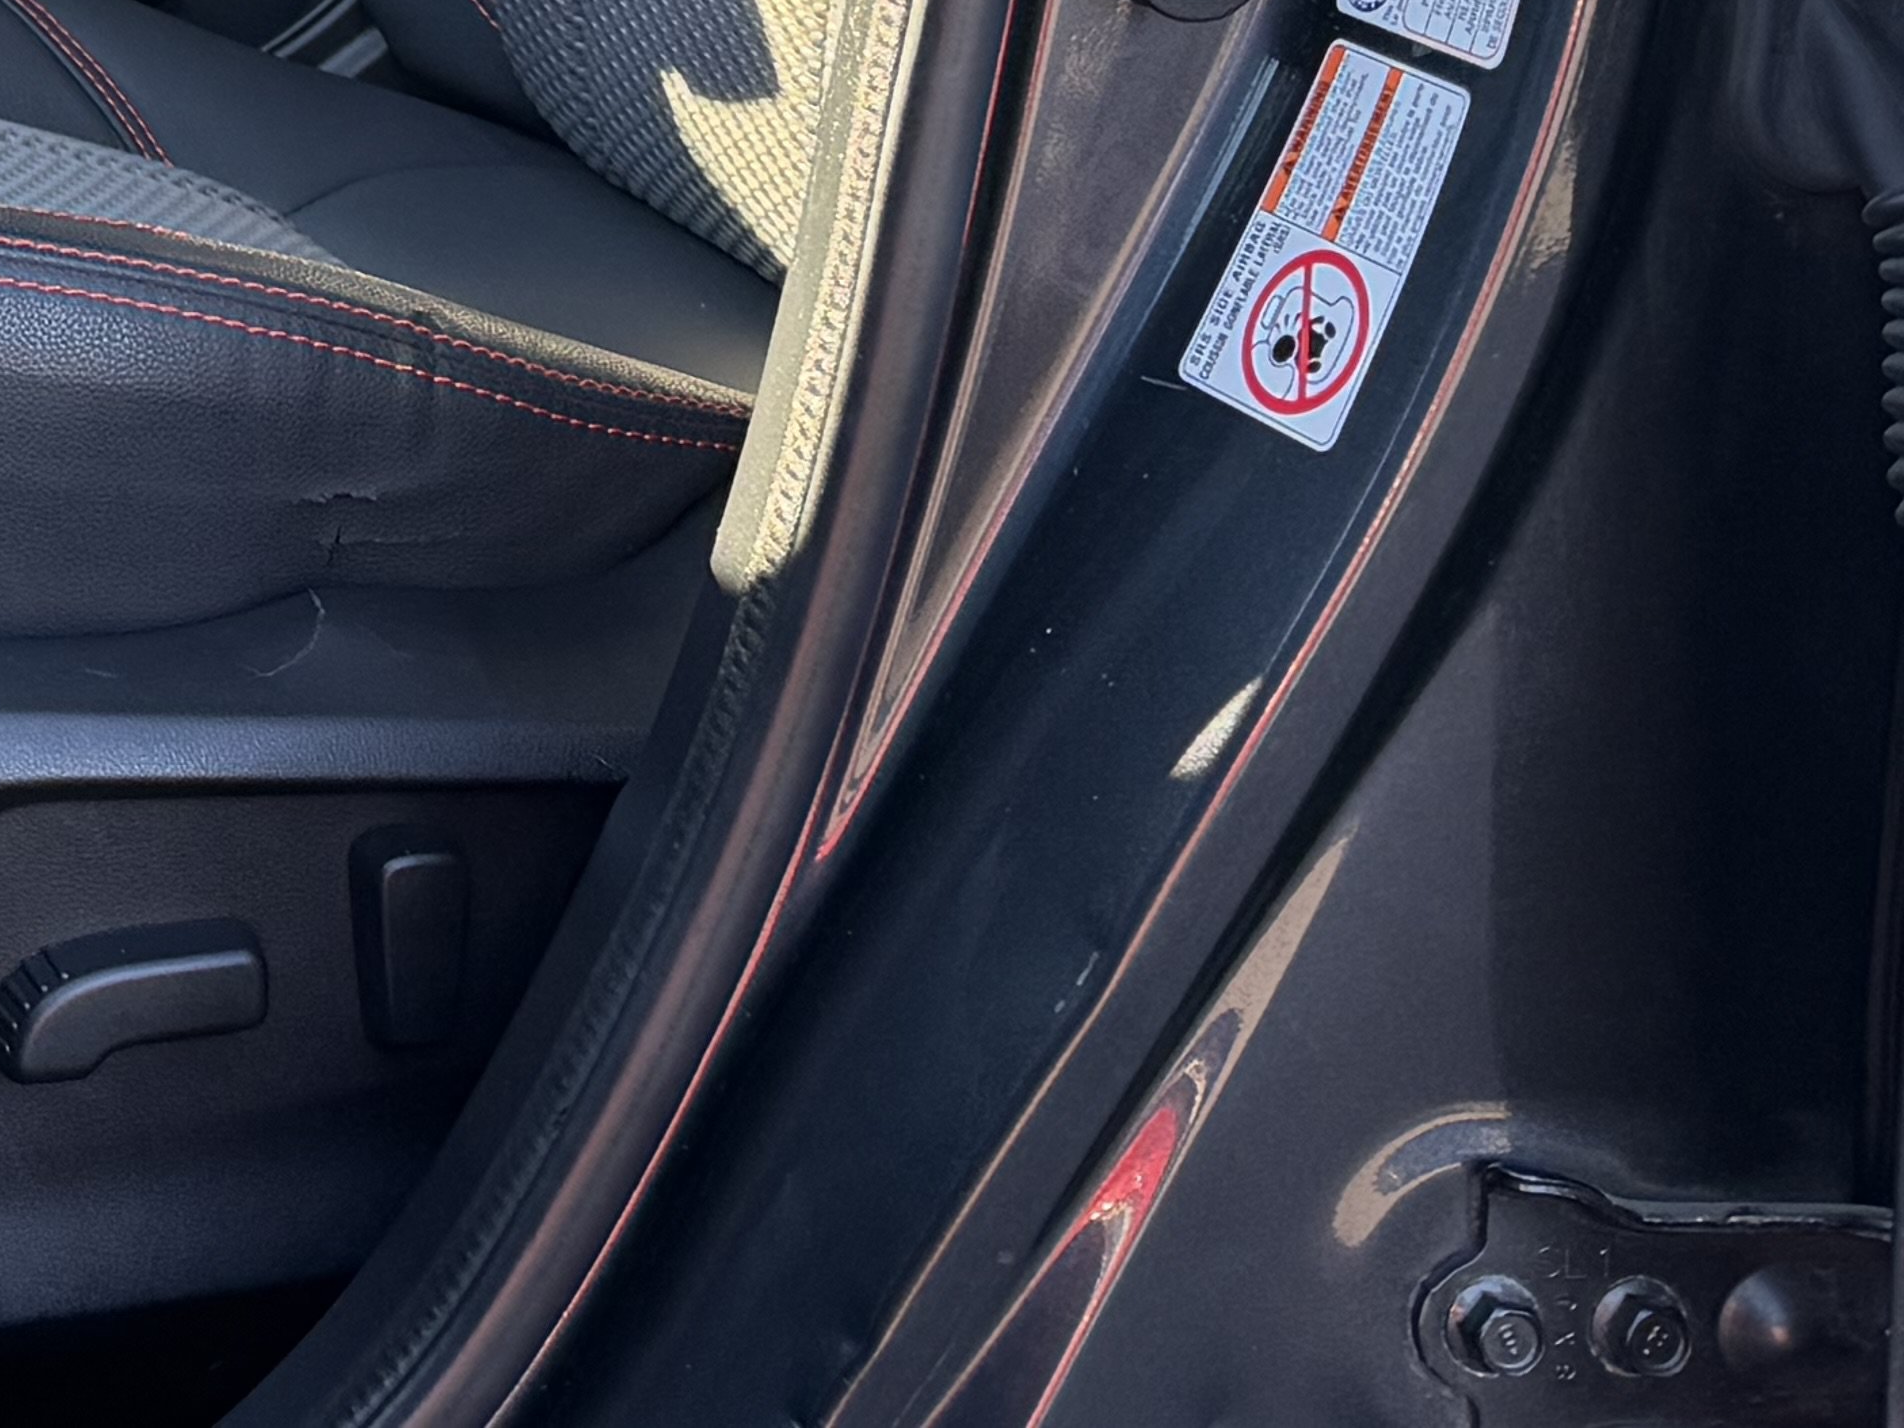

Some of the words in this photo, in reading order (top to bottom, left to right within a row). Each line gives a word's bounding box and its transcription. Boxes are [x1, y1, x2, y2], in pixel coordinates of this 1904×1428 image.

[1189, 332, 1212, 366] SRS
[1209, 289, 1233, 326] SIDE
[1231, 220, 1266, 282] AIRBAG
[1198, 332, 1228, 380] COUSSIN
[1223, 268, 1259, 330] GONFLABLE
